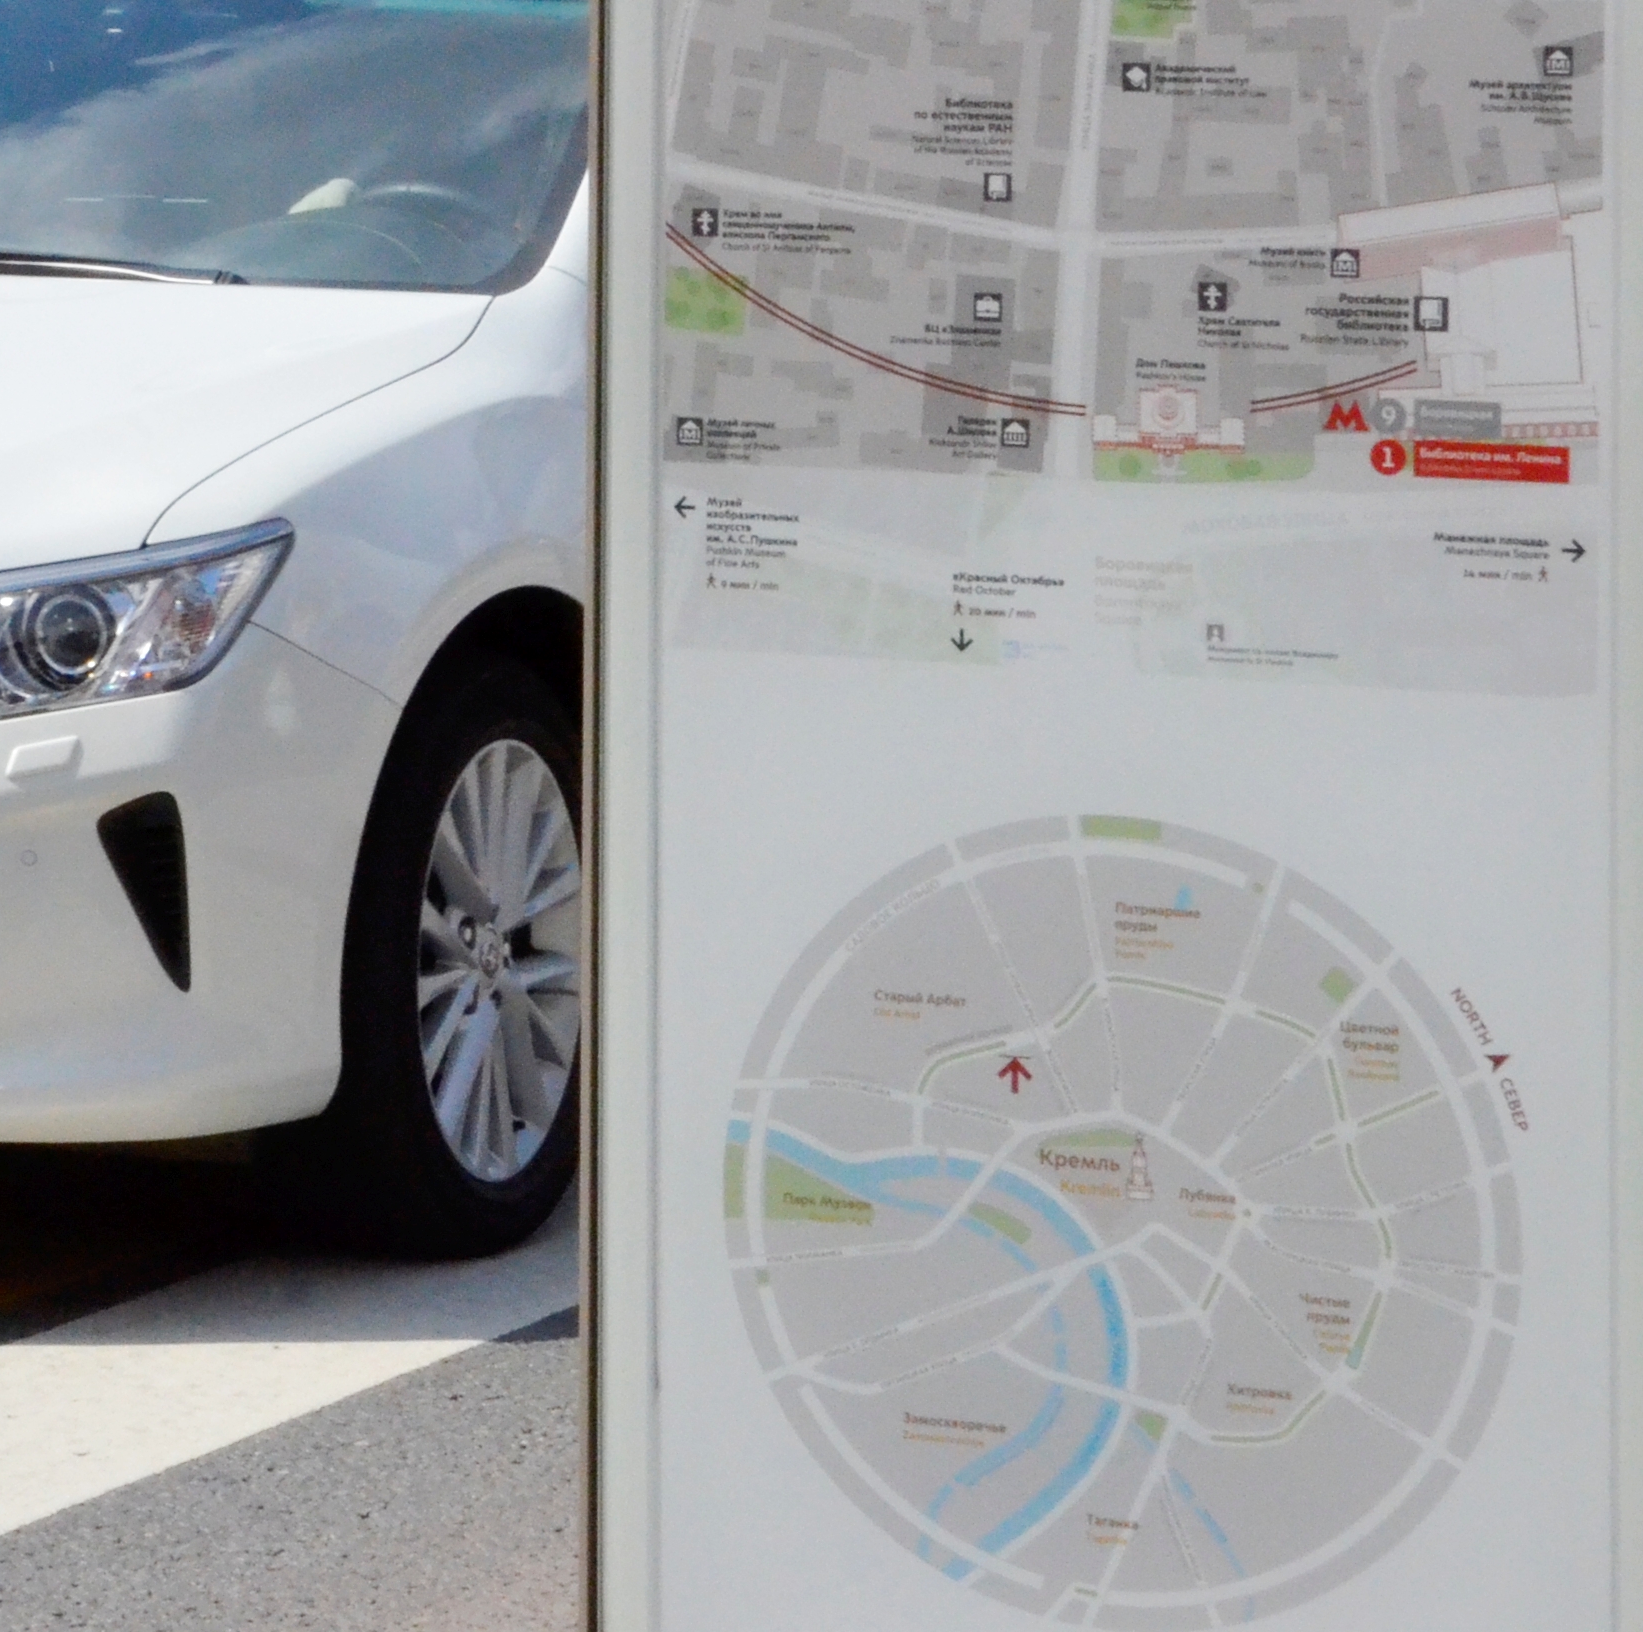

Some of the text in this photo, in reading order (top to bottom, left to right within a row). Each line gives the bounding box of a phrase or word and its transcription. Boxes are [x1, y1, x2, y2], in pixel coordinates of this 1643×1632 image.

[1338, 293, 1410, 307] Российская
[1380, 406, 1397, 426] 9
[1382, 446, 1395, 468] 1
[1419, 446, 1492, 463] Библиотека
[1515, 451, 1563, 466] Ленина
[705, 496, 743, 510] Музей
[952, 583, 972, 596] Red
[873, 988, 967, 1010] Старый Арбат
[1449, 986, 1495, 1048] NORTH
[1498, 1075, 1530, 1136] СЕВЕР
[1038, 1147, 1122, 1177] Кремль
[1059, 1179, 1123, 1201] Kremlin
